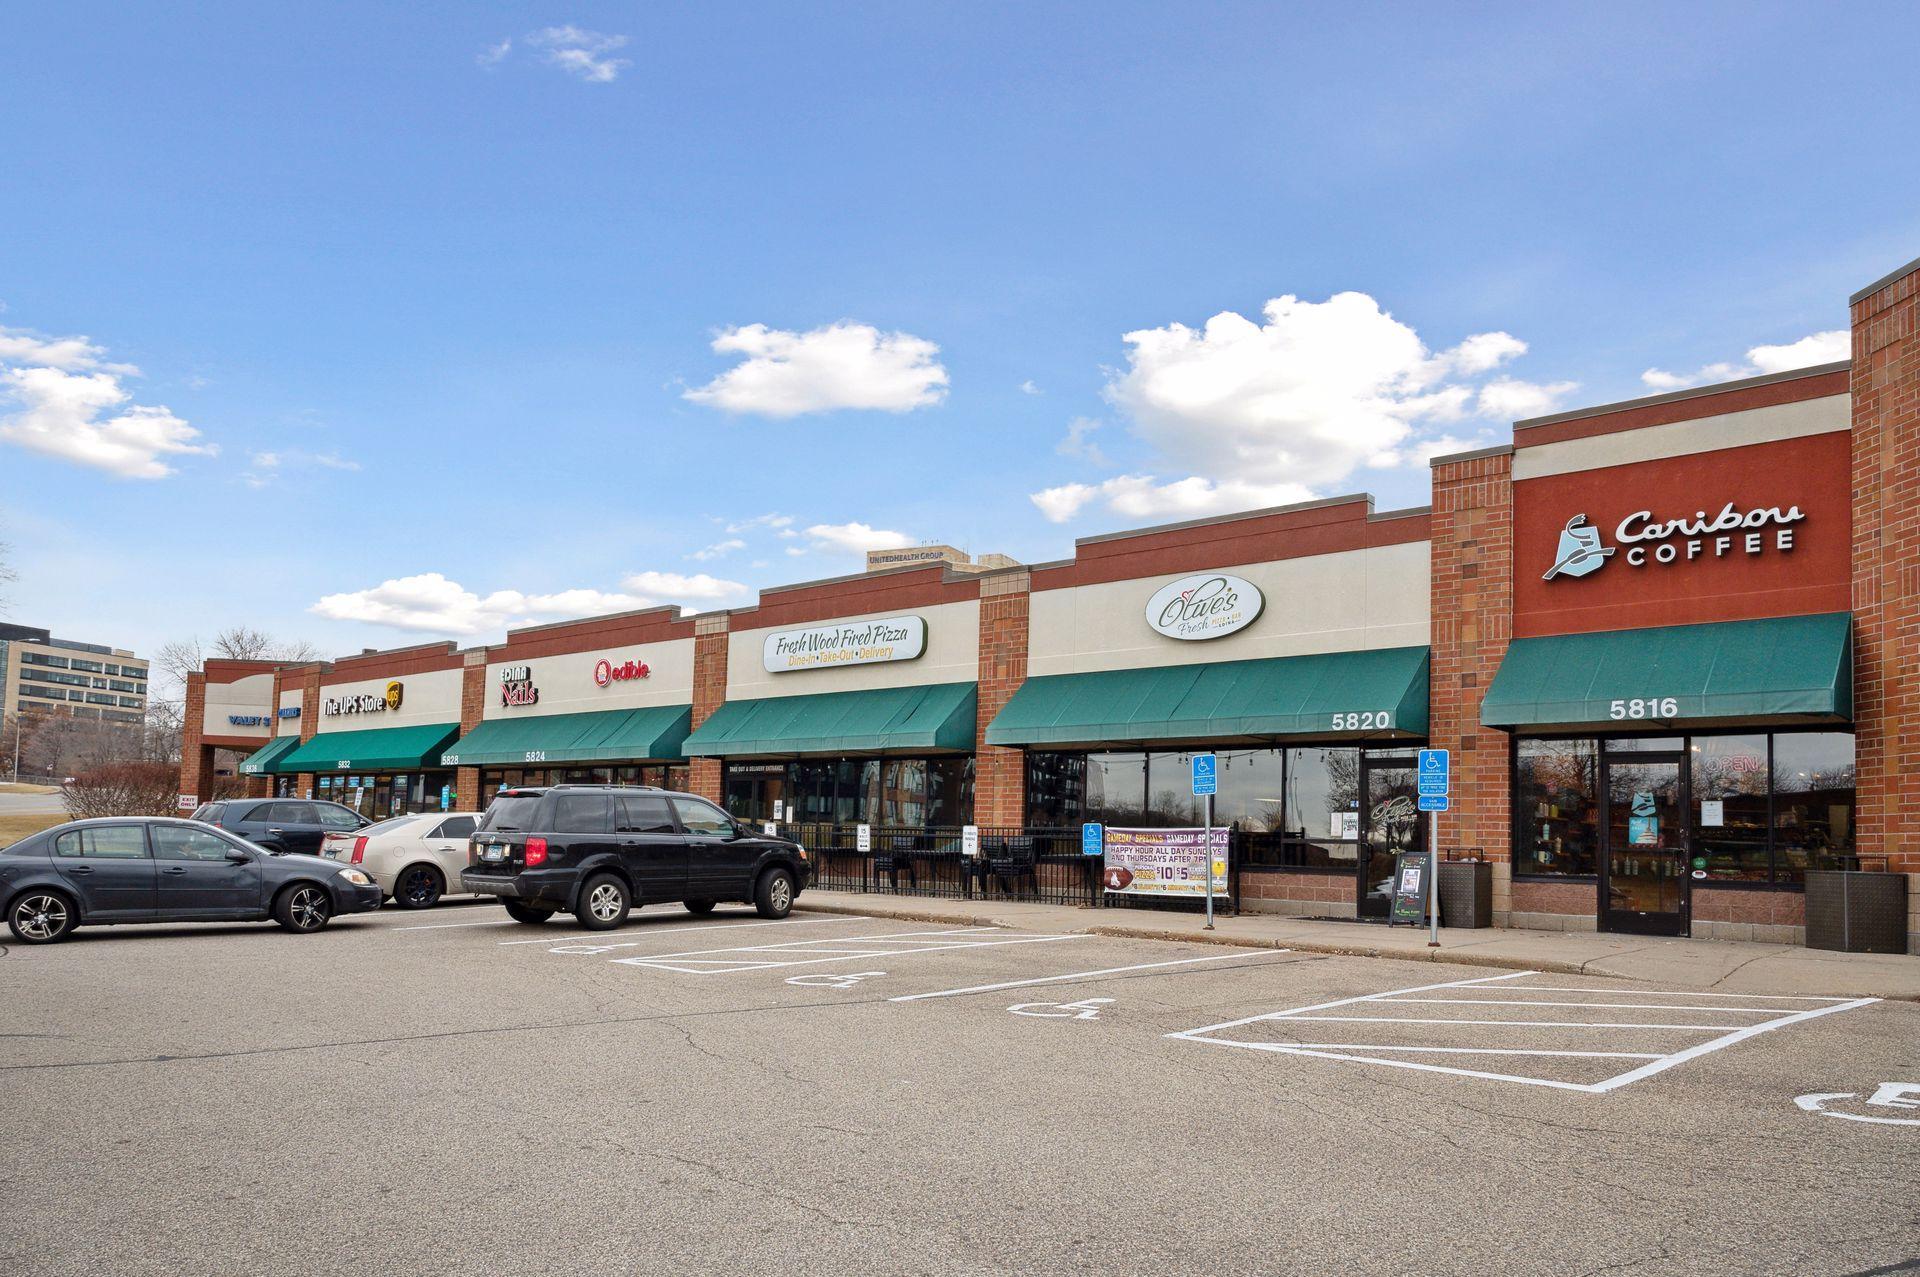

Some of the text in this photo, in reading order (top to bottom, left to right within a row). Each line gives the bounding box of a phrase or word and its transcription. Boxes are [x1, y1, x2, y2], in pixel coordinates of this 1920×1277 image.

[1615, 502, 1806, 543] Caribou
[920, 551, 944, 560] GROUP
[1626, 529, 1793, 567] COFFEE
[1158, 577, 1238, 628] Olive's
[1177, 617, 1210, 636] Fresh
[776, 625, 908, 655] Fresh Wood Fired Pizza
[819, 648, 855, 662] Take-Out
[859, 646, 894, 660] Delivery
[501, 665, 528, 682] EDINA
[611, 659, 651, 682] edible
[500, 681, 537, 706] Nails
[323, 694, 383, 715] The UPS Store
[1609, 697, 1679, 720] 5816
[1331, 711, 1390, 731] 5820
[337, 760, 351, 769] 5832
[442, 755, 459, 765] 5828
[525, 750, 546, 762] 5824
[1704, 755, 1760, 773] OPEN
[1106, 833, 1228, 844] GAMEDAY SPECIALS GAMEDAY SPCIALS
[1135, 847, 1154, 855] HOUR
[1155, 847, 1168, 855] ALL
[1188, 848, 1222, 856] SUNDYS
[1168, 855, 1192, 863] AFTER
[1134, 869, 1156, 880] PIZZA
[1156, 866, 1173, 880] $10
[1176, 867, 1188, 880] $5
